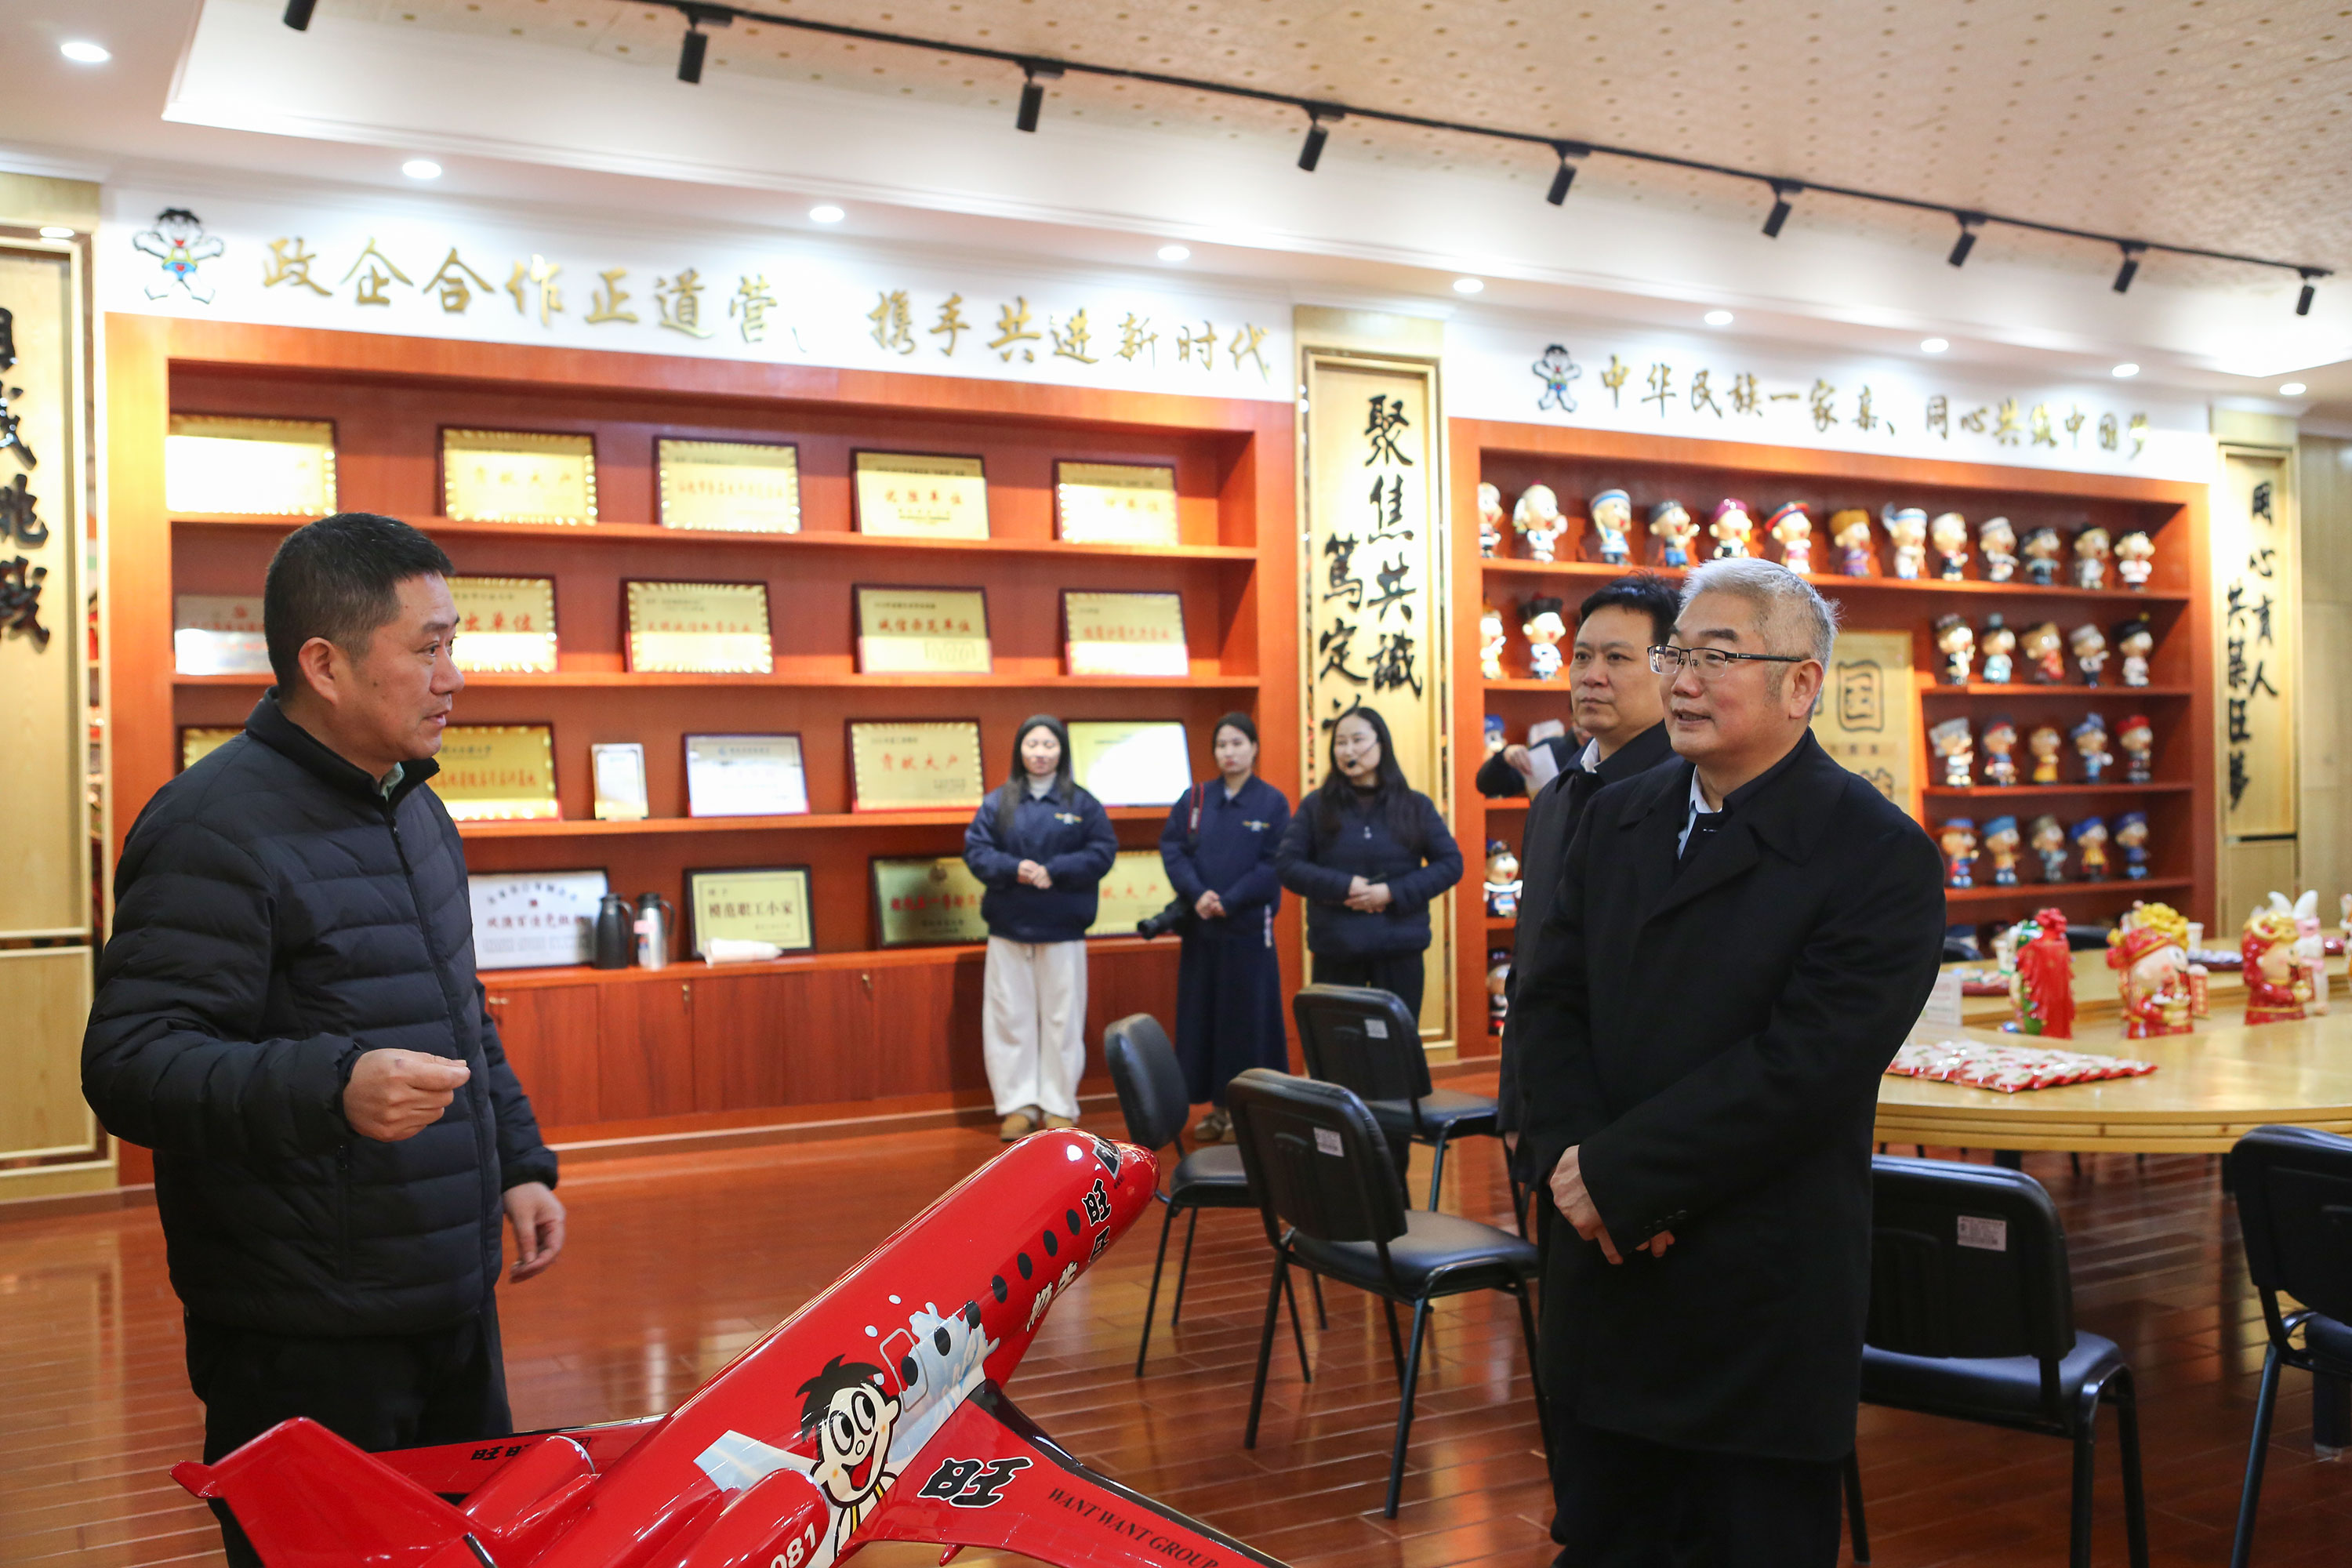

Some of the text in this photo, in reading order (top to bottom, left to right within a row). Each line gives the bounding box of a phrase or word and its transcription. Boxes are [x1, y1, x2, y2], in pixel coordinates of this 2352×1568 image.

[1364, 394, 1422, 702] 聚焦共識
[708, 901, 793, 918] 模范职工小家
[916, 1457, 1034, 1508] 旺
[1047, 1488, 1100, 1517] WANT
[1098, 1510, 1153, 1541] WANT
